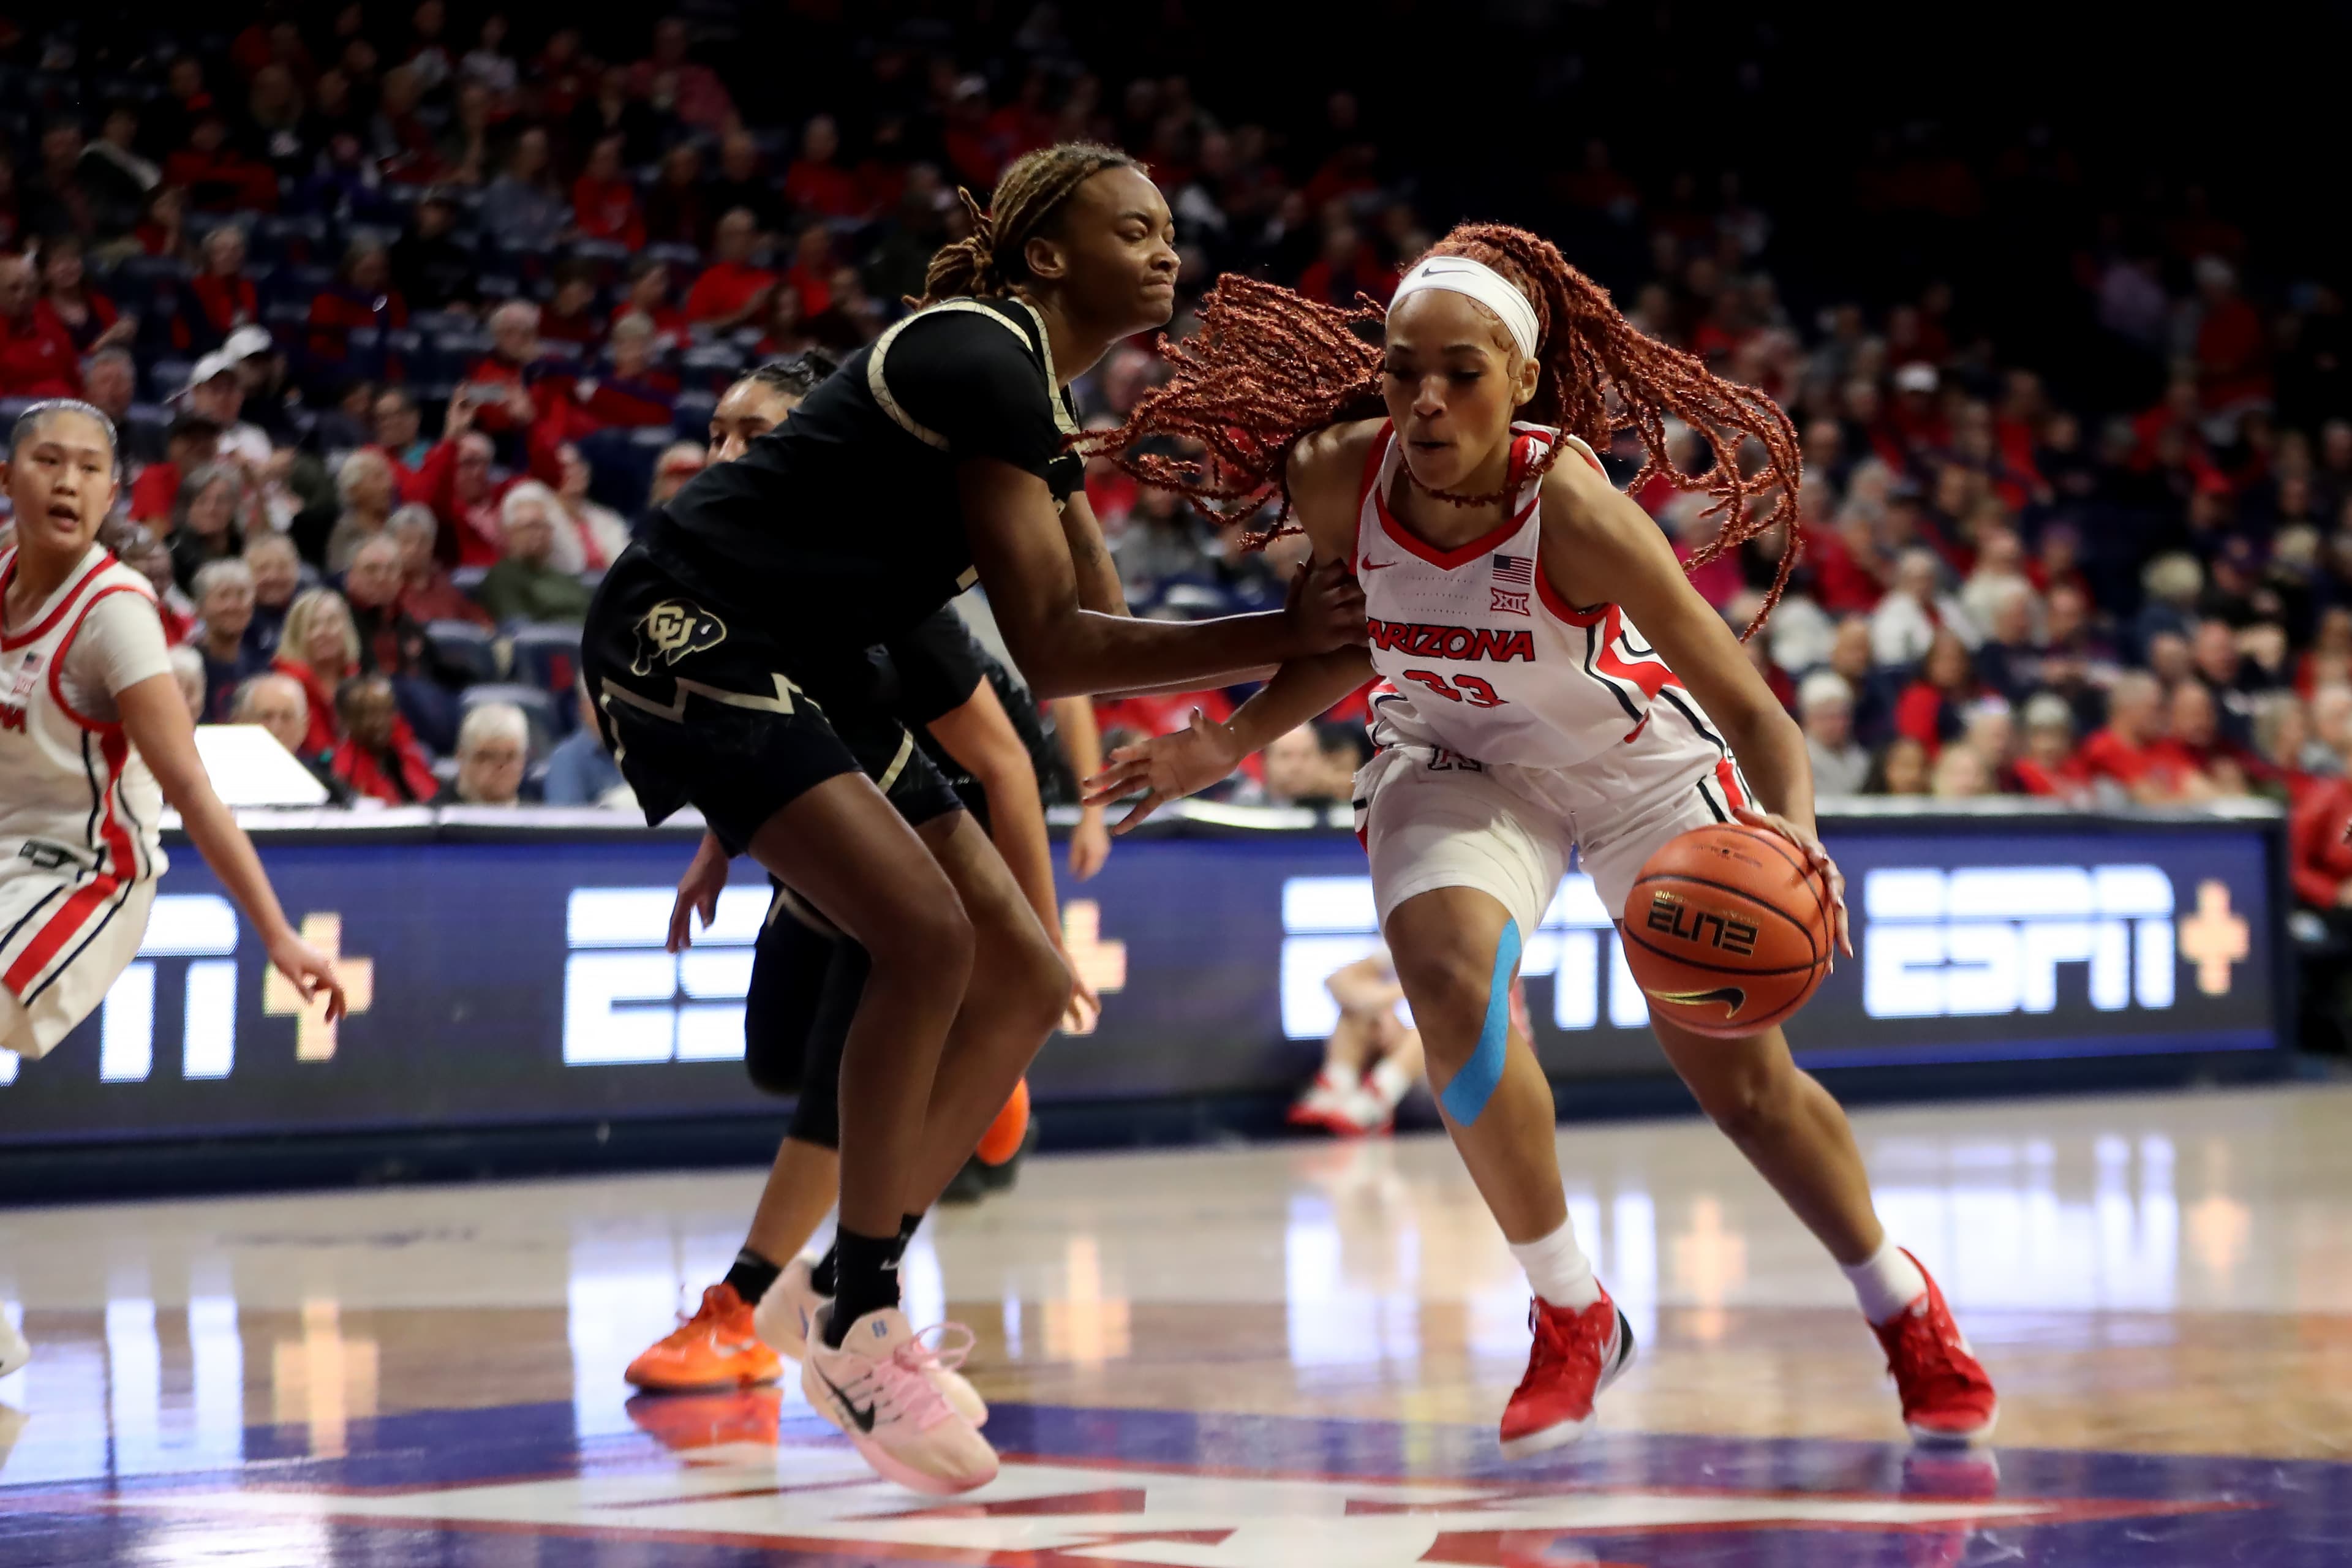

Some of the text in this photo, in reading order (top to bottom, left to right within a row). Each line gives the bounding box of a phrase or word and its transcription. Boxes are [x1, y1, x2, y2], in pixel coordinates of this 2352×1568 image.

[1490, 586, 1531, 616] XII
[649, 605, 697, 650] CU
[1366, 617, 1536, 662] ARIZONA
[1402, 669, 1510, 708] 33
[1647, 898, 1759, 957] ELITE
